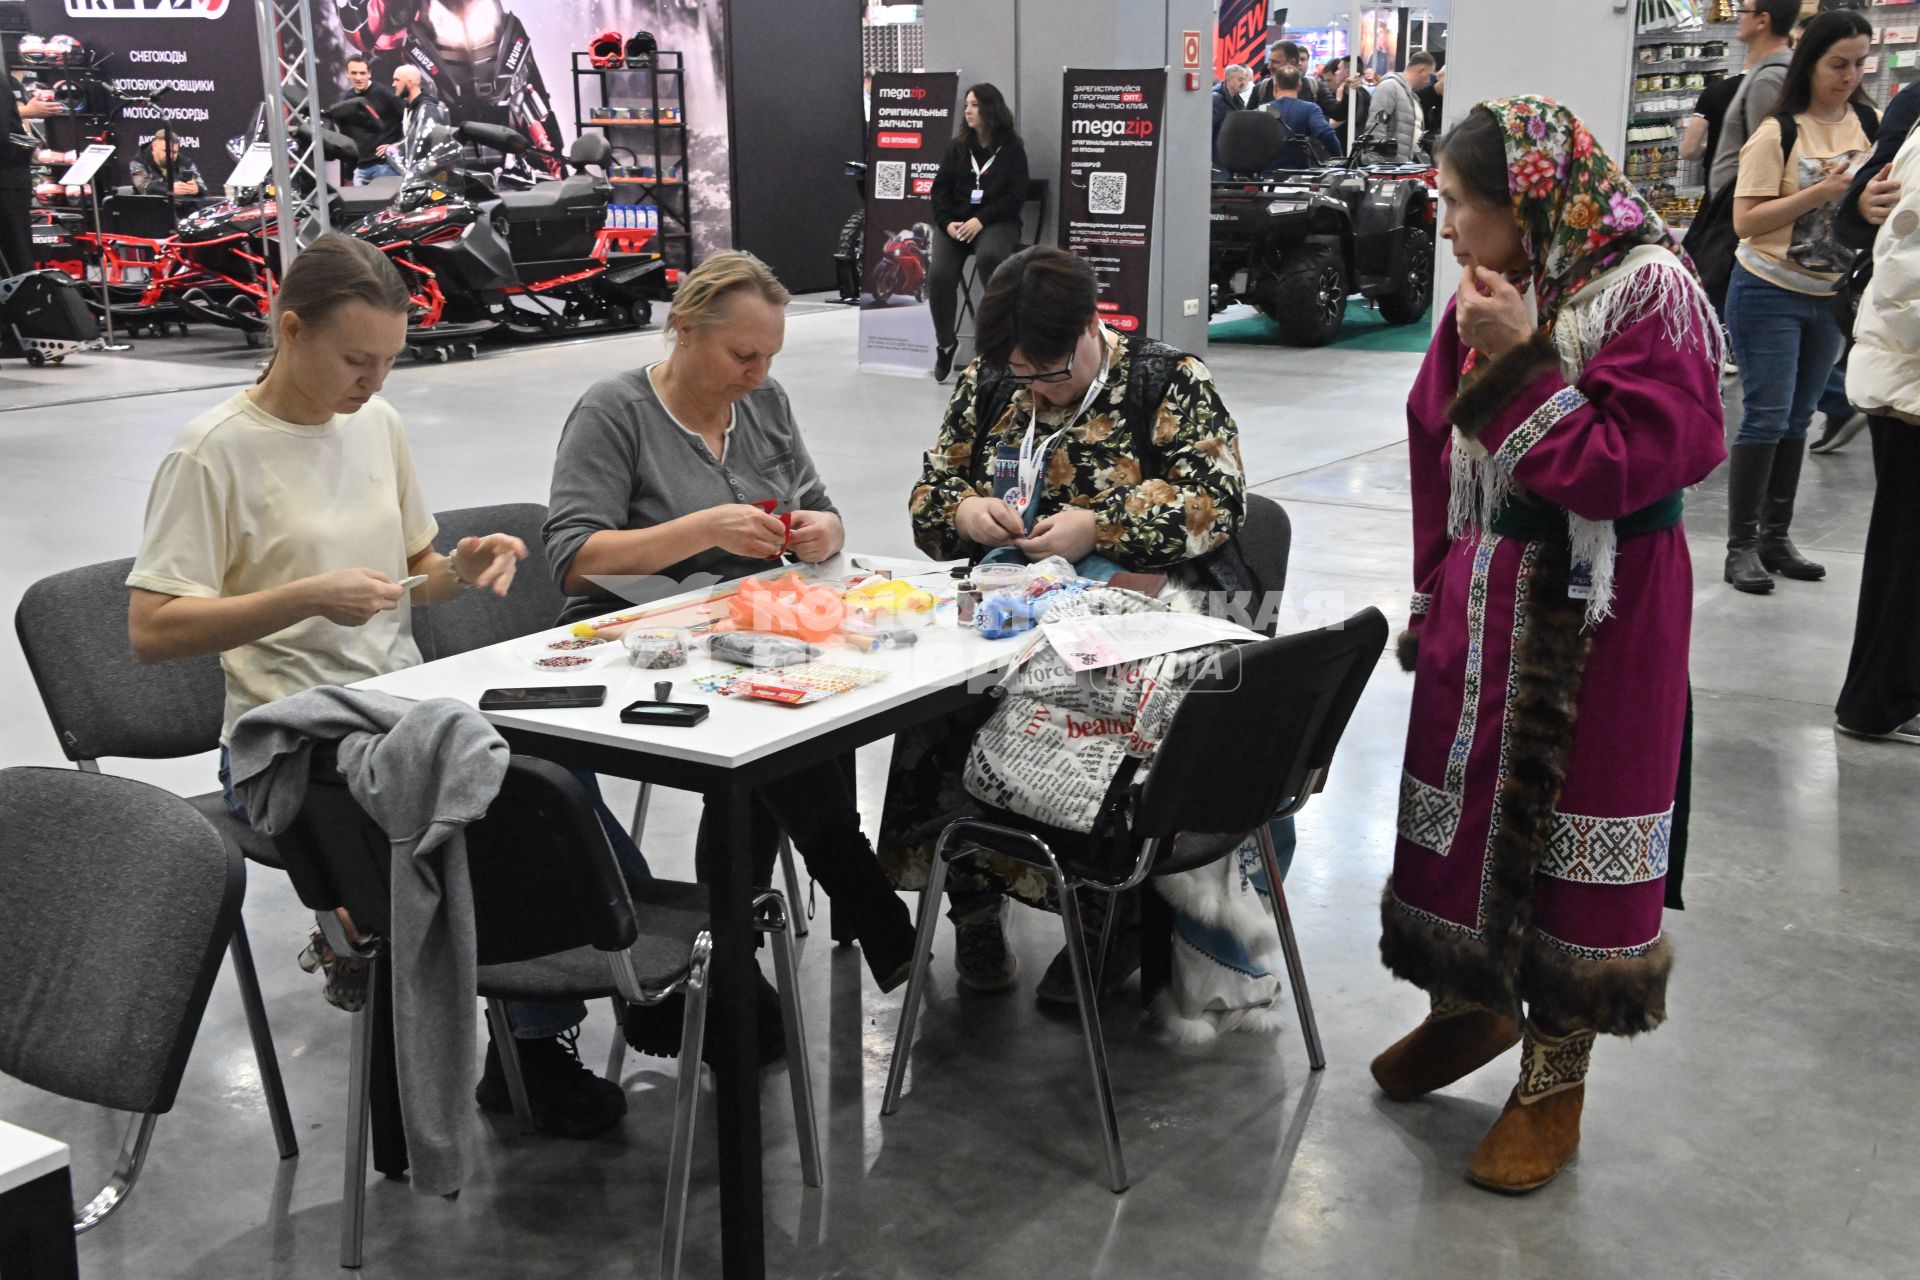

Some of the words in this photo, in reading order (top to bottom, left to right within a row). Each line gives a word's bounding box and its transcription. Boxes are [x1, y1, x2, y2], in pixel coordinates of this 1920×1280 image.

[1223, 0, 1267, 68] NEW
[129, 50, 187, 64] СНЕГОХОДЫ
[879, 87, 926, 100] megazip
[1073, 84, 1141, 93] ЗАРЕГИСТРИРУЙСЯ
[1072, 93, 1079, 101] В
[1079, 93, 1121, 101] ПРОГРАММЕ
[1096, 102, 1125, 110] ЧАСТЬЮ
[878, 107, 949, 118] ОРИГИНАЛЬНЫЕ
[878, 119, 924, 129] ЗАПЧАСТИ
[1071, 116, 1153, 138] megazip
[916, 181, 934, 192] 25
